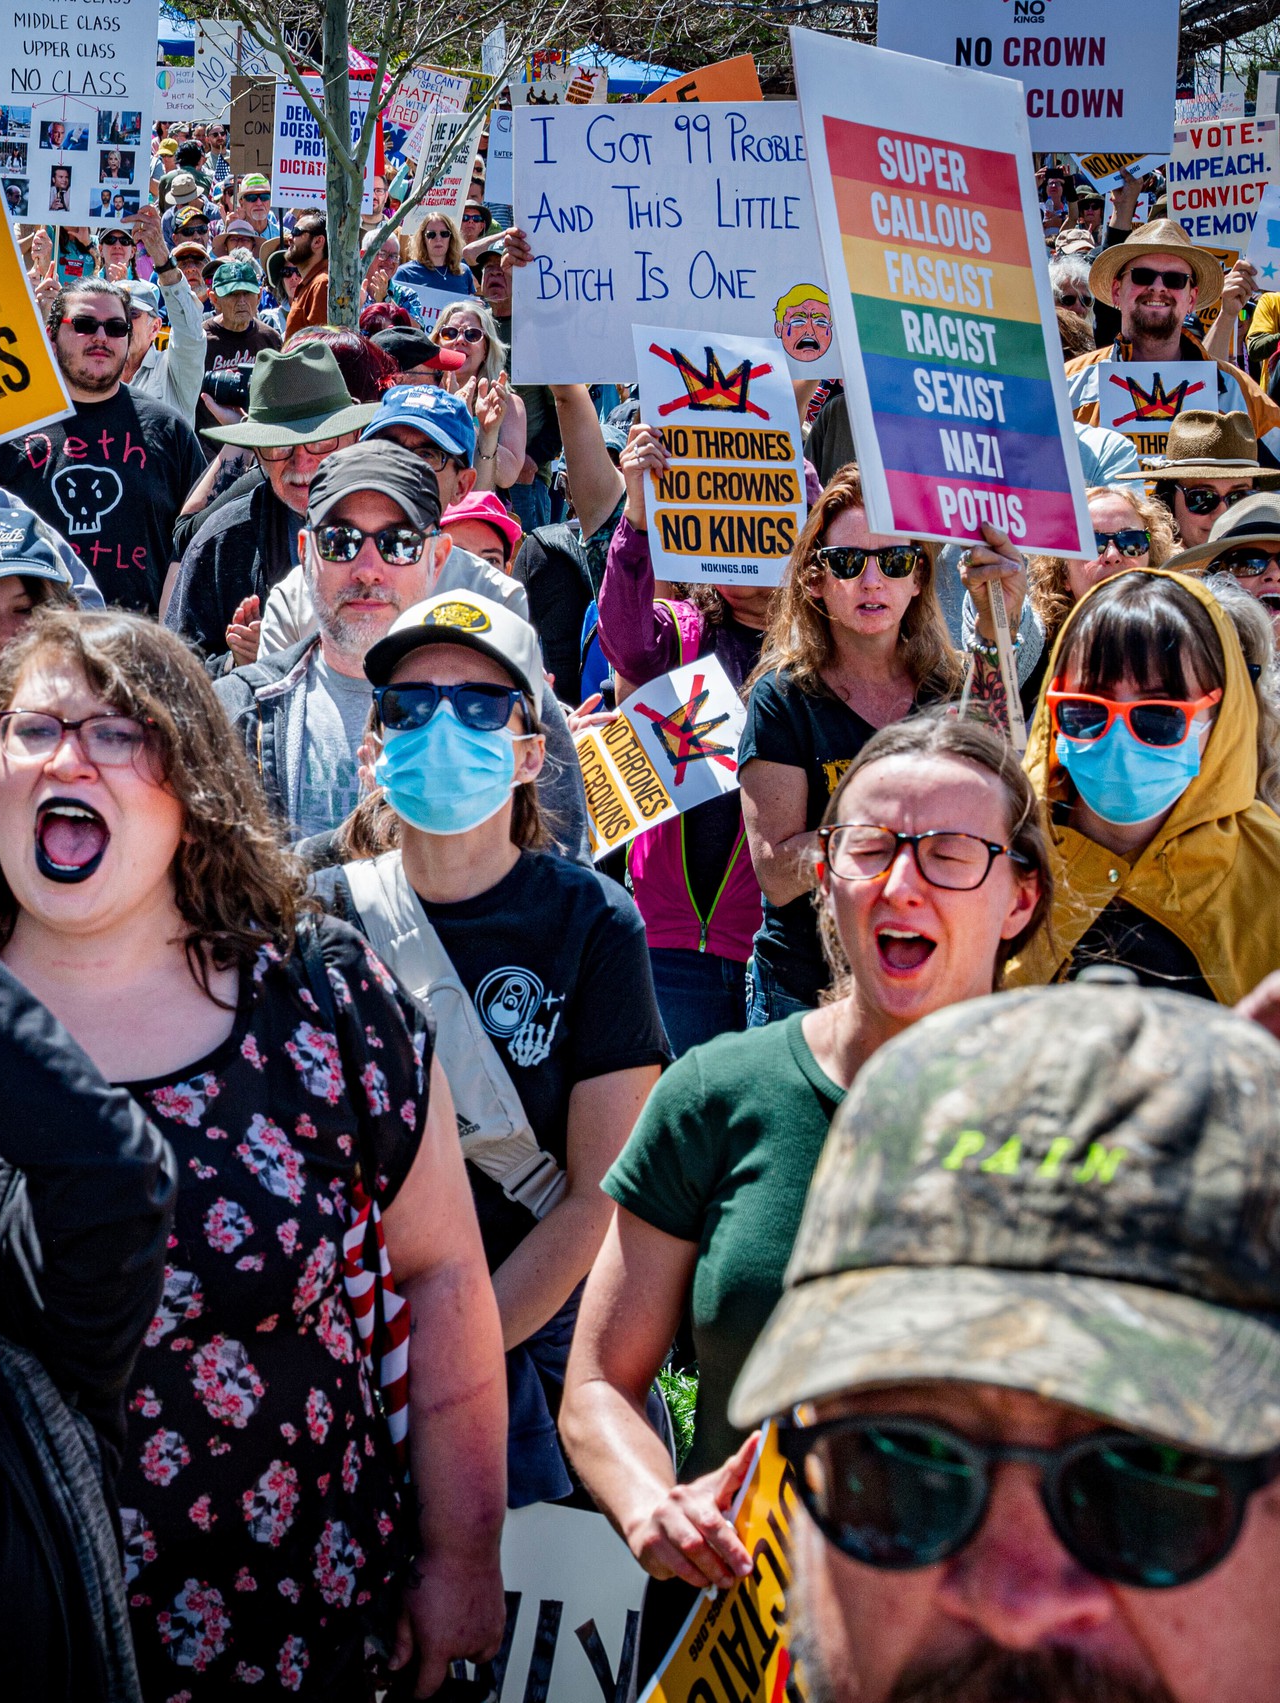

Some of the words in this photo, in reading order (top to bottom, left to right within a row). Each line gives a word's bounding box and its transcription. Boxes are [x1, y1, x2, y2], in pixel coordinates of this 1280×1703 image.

[14, 12, 69, 30] MIDDLE
[77, 15, 121, 32] CLASS
[1013, 15, 1045, 23] KINGS
[1014, 1, 1045, 15] NO
[23, 40, 70, 58] UPPER
[76, 43, 116, 60] CLASS
[284, 28, 312, 49] NO
[955, 37, 993, 67] NO
[1002, 36, 1107, 67] CROWN
[11, 68, 42, 92] NO
[52, 70, 127, 96] CLASS
[411, 68, 431, 81] YOU
[420, 81, 443, 94] SPELL
[392, 105, 419, 123] RED
[405, 99, 428, 112] WITH
[1026, 88, 1124, 119] CLOWN
[435, 123, 448, 141] HE
[530, 116, 557, 164] I
[674, 114, 712, 164] 99
[1190, 122, 1264, 150] VOTE.
[878, 136, 969, 195] SUPER
[1085, 158, 1109, 179] NO
[1169, 152, 1272, 182] IMPEACH.
[1172, 182, 1269, 212] CONVICT
[871, 191, 992, 254] CALLOUS
[884, 250, 994, 310] FASCIST
[900, 309, 998, 366] RACIST
[914, 367, 1006, 423] SEXIST
[24, 429, 147, 469] Deth
[659, 428, 689, 458] NO
[692, 430, 792, 461] THRONES
[939, 428, 1005, 479] NAZI
[659, 469, 691, 501] NO
[696, 470, 795, 502] CROWNS
[937, 485, 1027, 539] POTUS
[661, 514, 701, 552] NO
[710, 515, 796, 556] KINGS
[700, 562, 759, 575] NOKINGS.ORG
[601, 714, 630, 746] NO
[612, 736, 669, 818] THRONES
[584, 763, 631, 841] CROWNS
[941, 1129, 1128, 1185] PAIN
